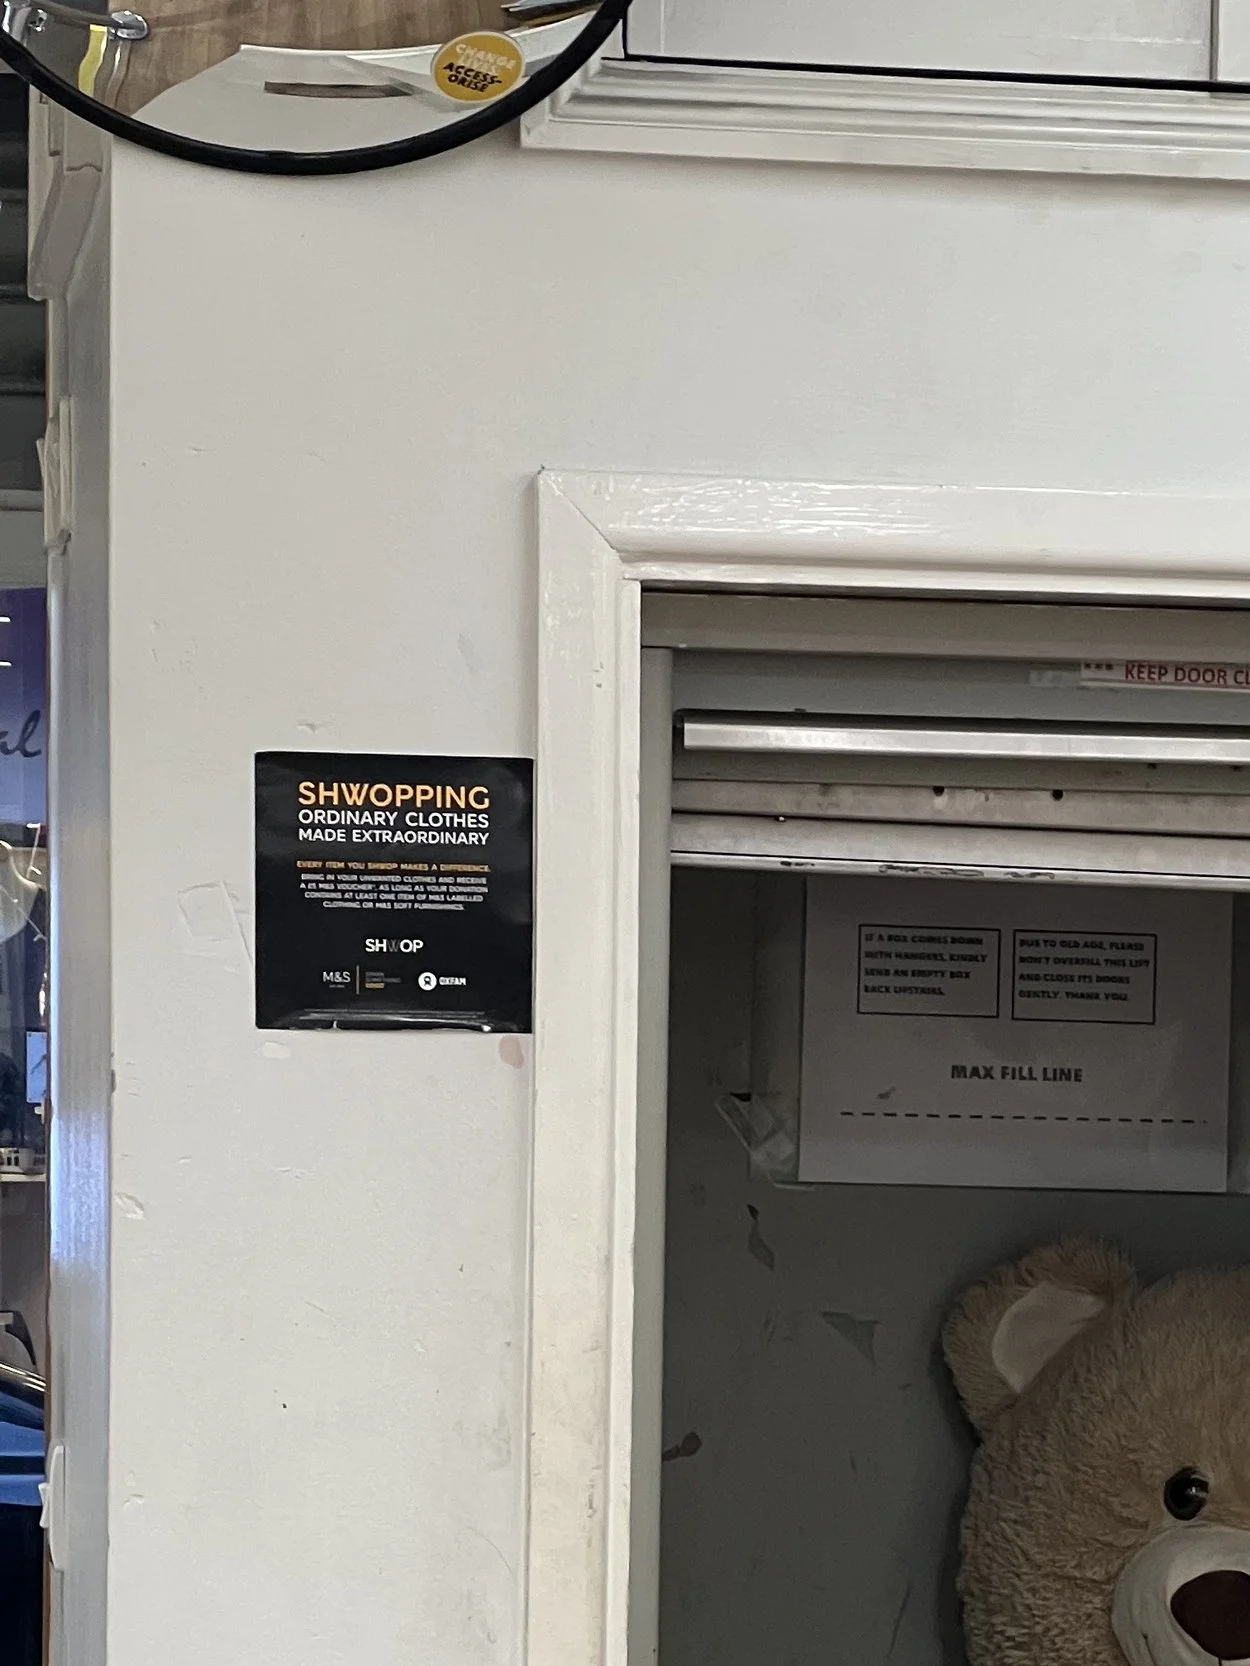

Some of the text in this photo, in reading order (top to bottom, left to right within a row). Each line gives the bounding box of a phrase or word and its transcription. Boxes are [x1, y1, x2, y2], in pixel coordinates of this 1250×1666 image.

[456, 44, 516, 69] CHANGE
[443, 62, 503, 84] ACCESS-
[448, 74, 489, 92] ORISE
[1124, 661, 1168, 682] KEEP
[1173, 665, 1228, 686] DOOR
[298, 781, 490, 810] SHWOPPING
[298, 809, 489, 828] ORDINARY CLOTHES
[298, 828, 490, 845] MADE EXTRAORDINARY
[297, 860, 322, 868] EVERY
[325, 861, 345, 869] ITEM
[400, 863, 428, 871] MAKES
[403, 875, 436, 883] CLOTHES
[391, 884, 412, 892] LONG
[355, 892, 377, 900] LEAST
[1042, 939, 1057, 948] TO
[949, 953, 987, 963] KINDLY
[1103, 958, 1126, 968] THIS
[1129, 959, 1150, 968] LIFT
[322, 971, 351, 983] M&S
[893, 968, 908, 977] AN
[911, 969, 945, 978] EMPTY
[949, 971, 970, 979] BOX
[1018, 973, 1041, 981] AND
[1043, 973, 1075, 983] CLOSE
[438, 976, 467, 986] OXFAM
[864, 985, 891, 993] BACK
[1065, 991, 1100, 1000] THANK
[950, 1064, 1083, 1083] MAX FILL LINE
